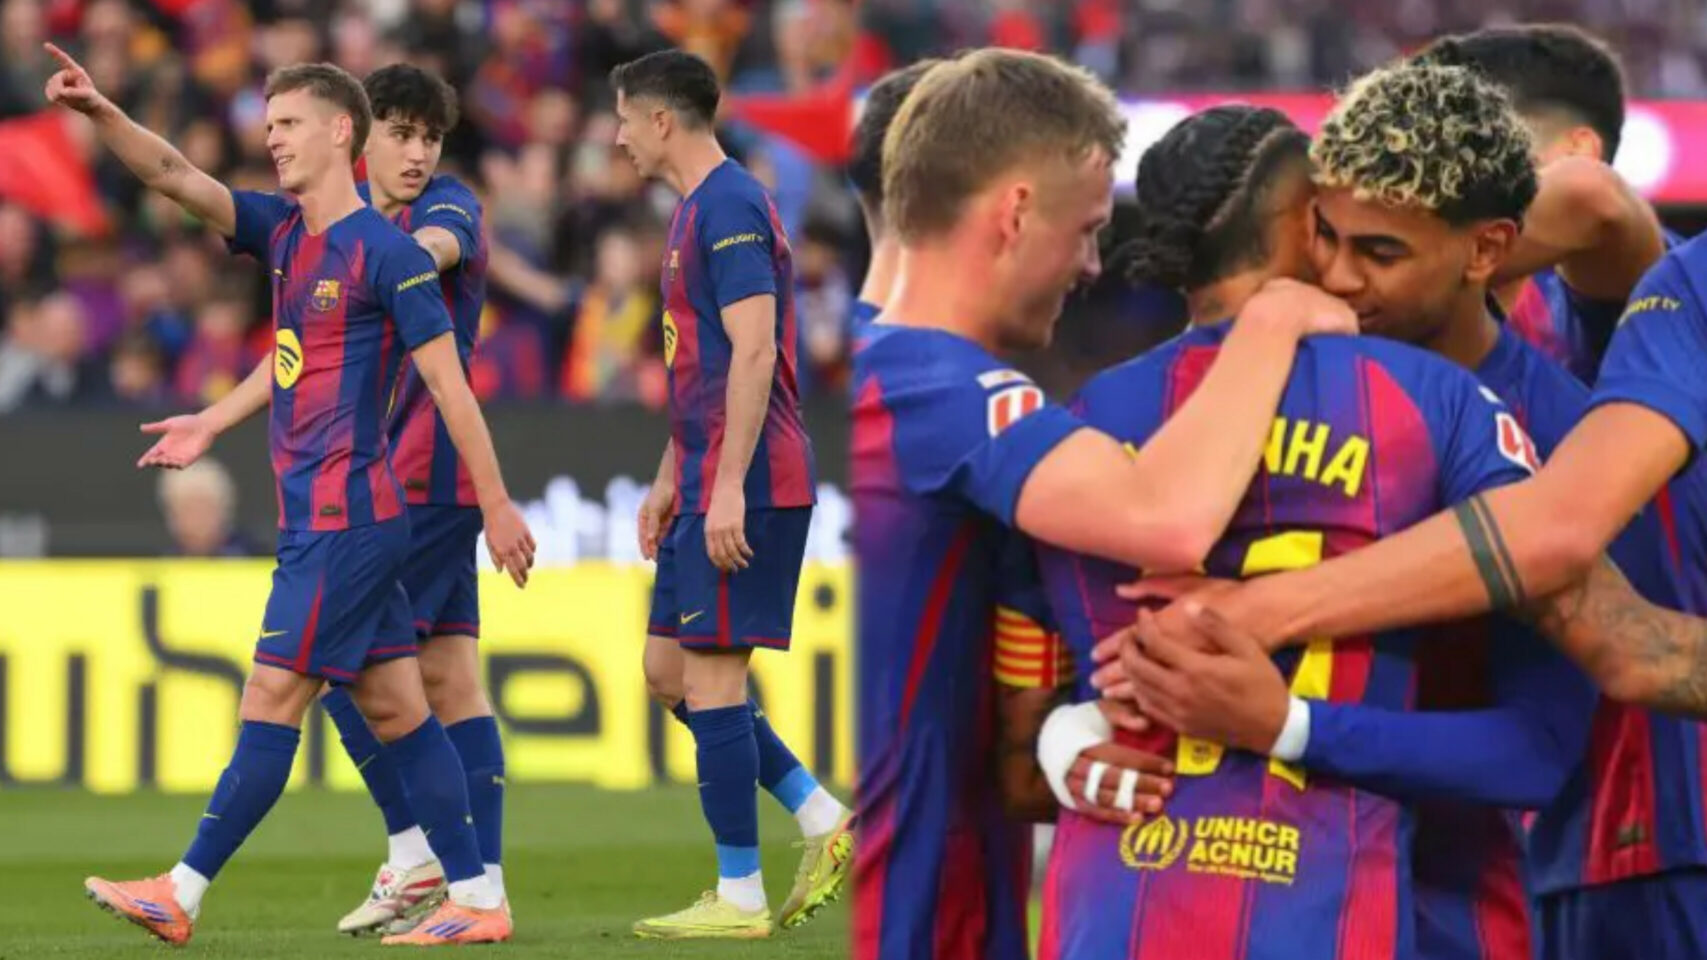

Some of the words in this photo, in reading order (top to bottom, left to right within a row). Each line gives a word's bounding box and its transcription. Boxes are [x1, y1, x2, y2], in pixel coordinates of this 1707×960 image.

[1264, 417, 1369, 497] NHA
[1194, 817, 1299, 850] UNHCR
[1188, 841, 1297, 873] ACNUR
